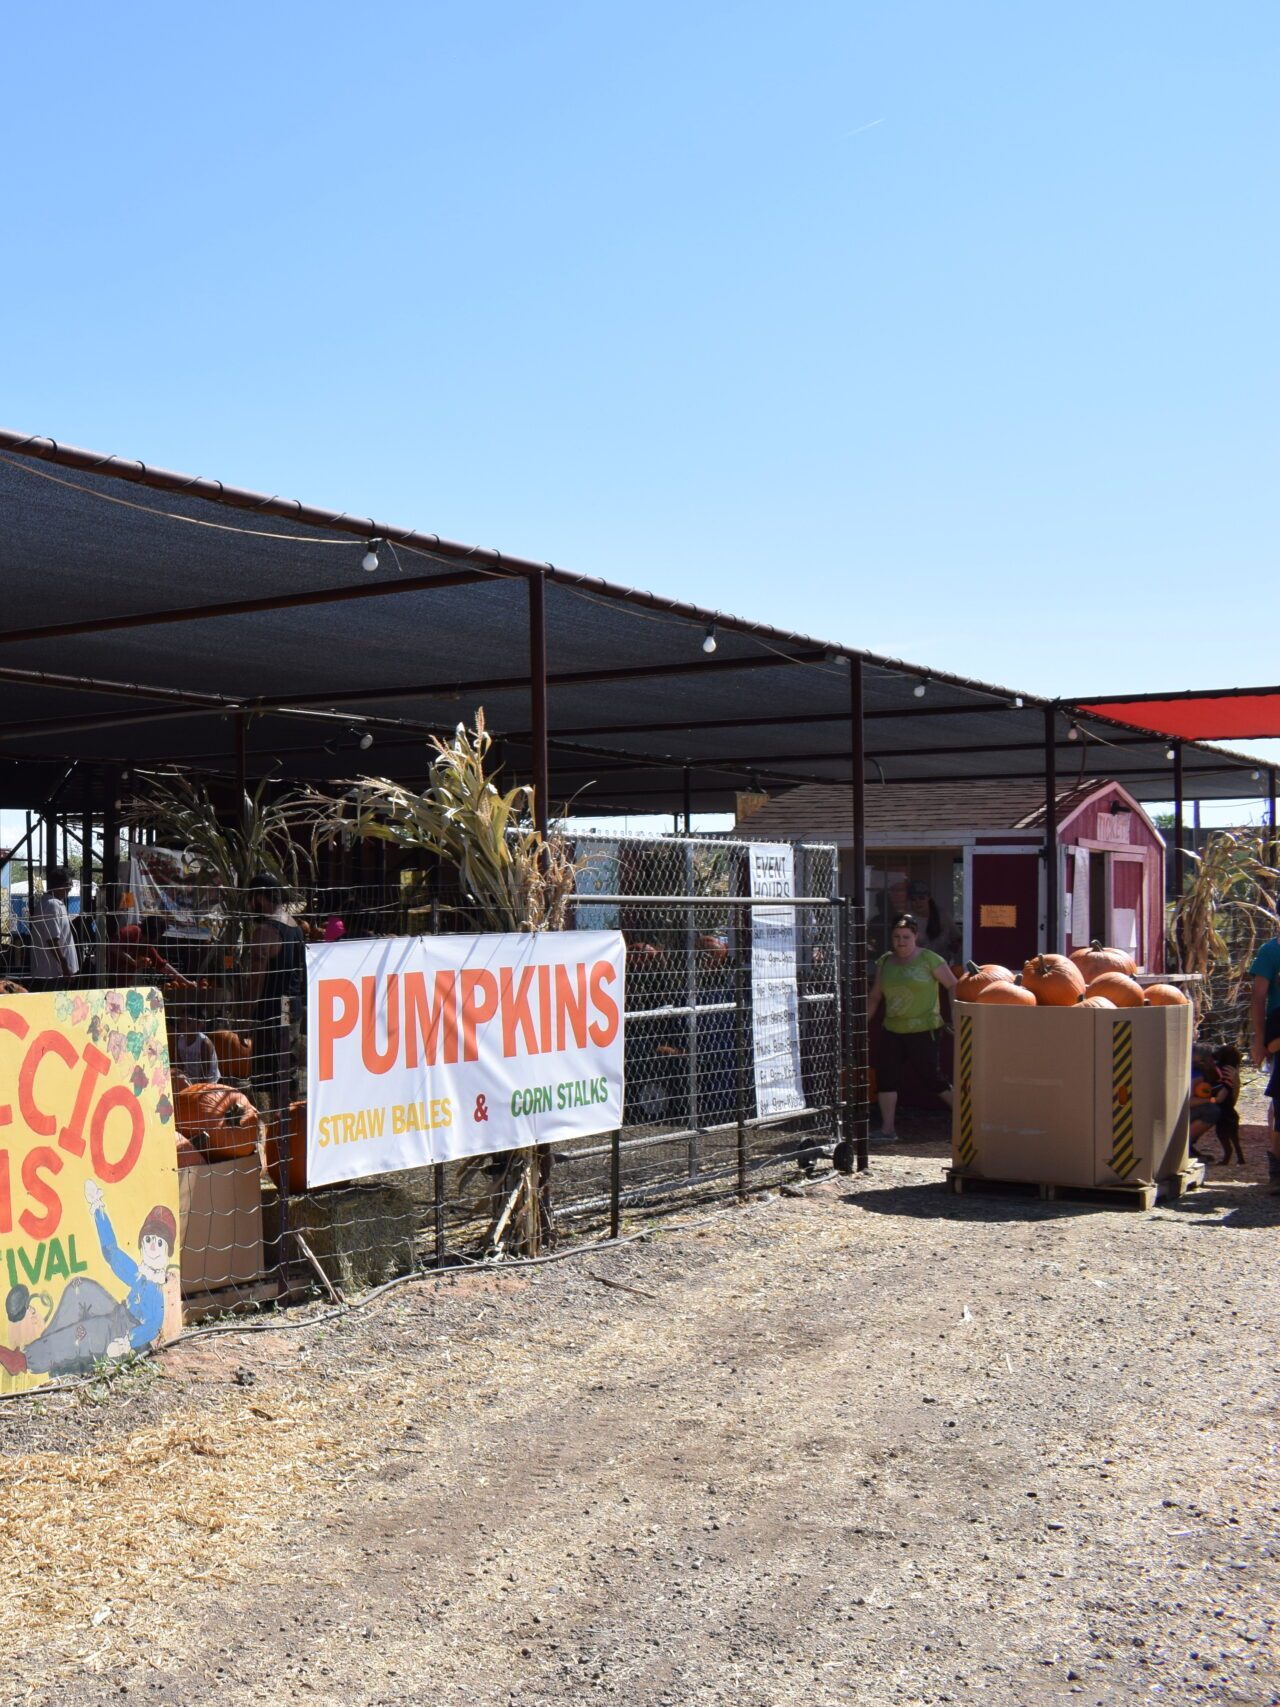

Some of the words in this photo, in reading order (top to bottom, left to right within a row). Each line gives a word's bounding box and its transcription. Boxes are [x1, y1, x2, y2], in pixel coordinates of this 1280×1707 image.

[754, 881, 790, 897] HOURS
[755, 856, 786, 878] EVENT
[318, 960, 619, 1081] PUMPKINS
[318, 1107, 385, 1148] STRAW
[392, 1097, 452, 1135] BALES
[473, 1093, 488, 1123] &
[510, 1083, 553, 1118] CORN
[557, 1076, 608, 1110] STALKS
